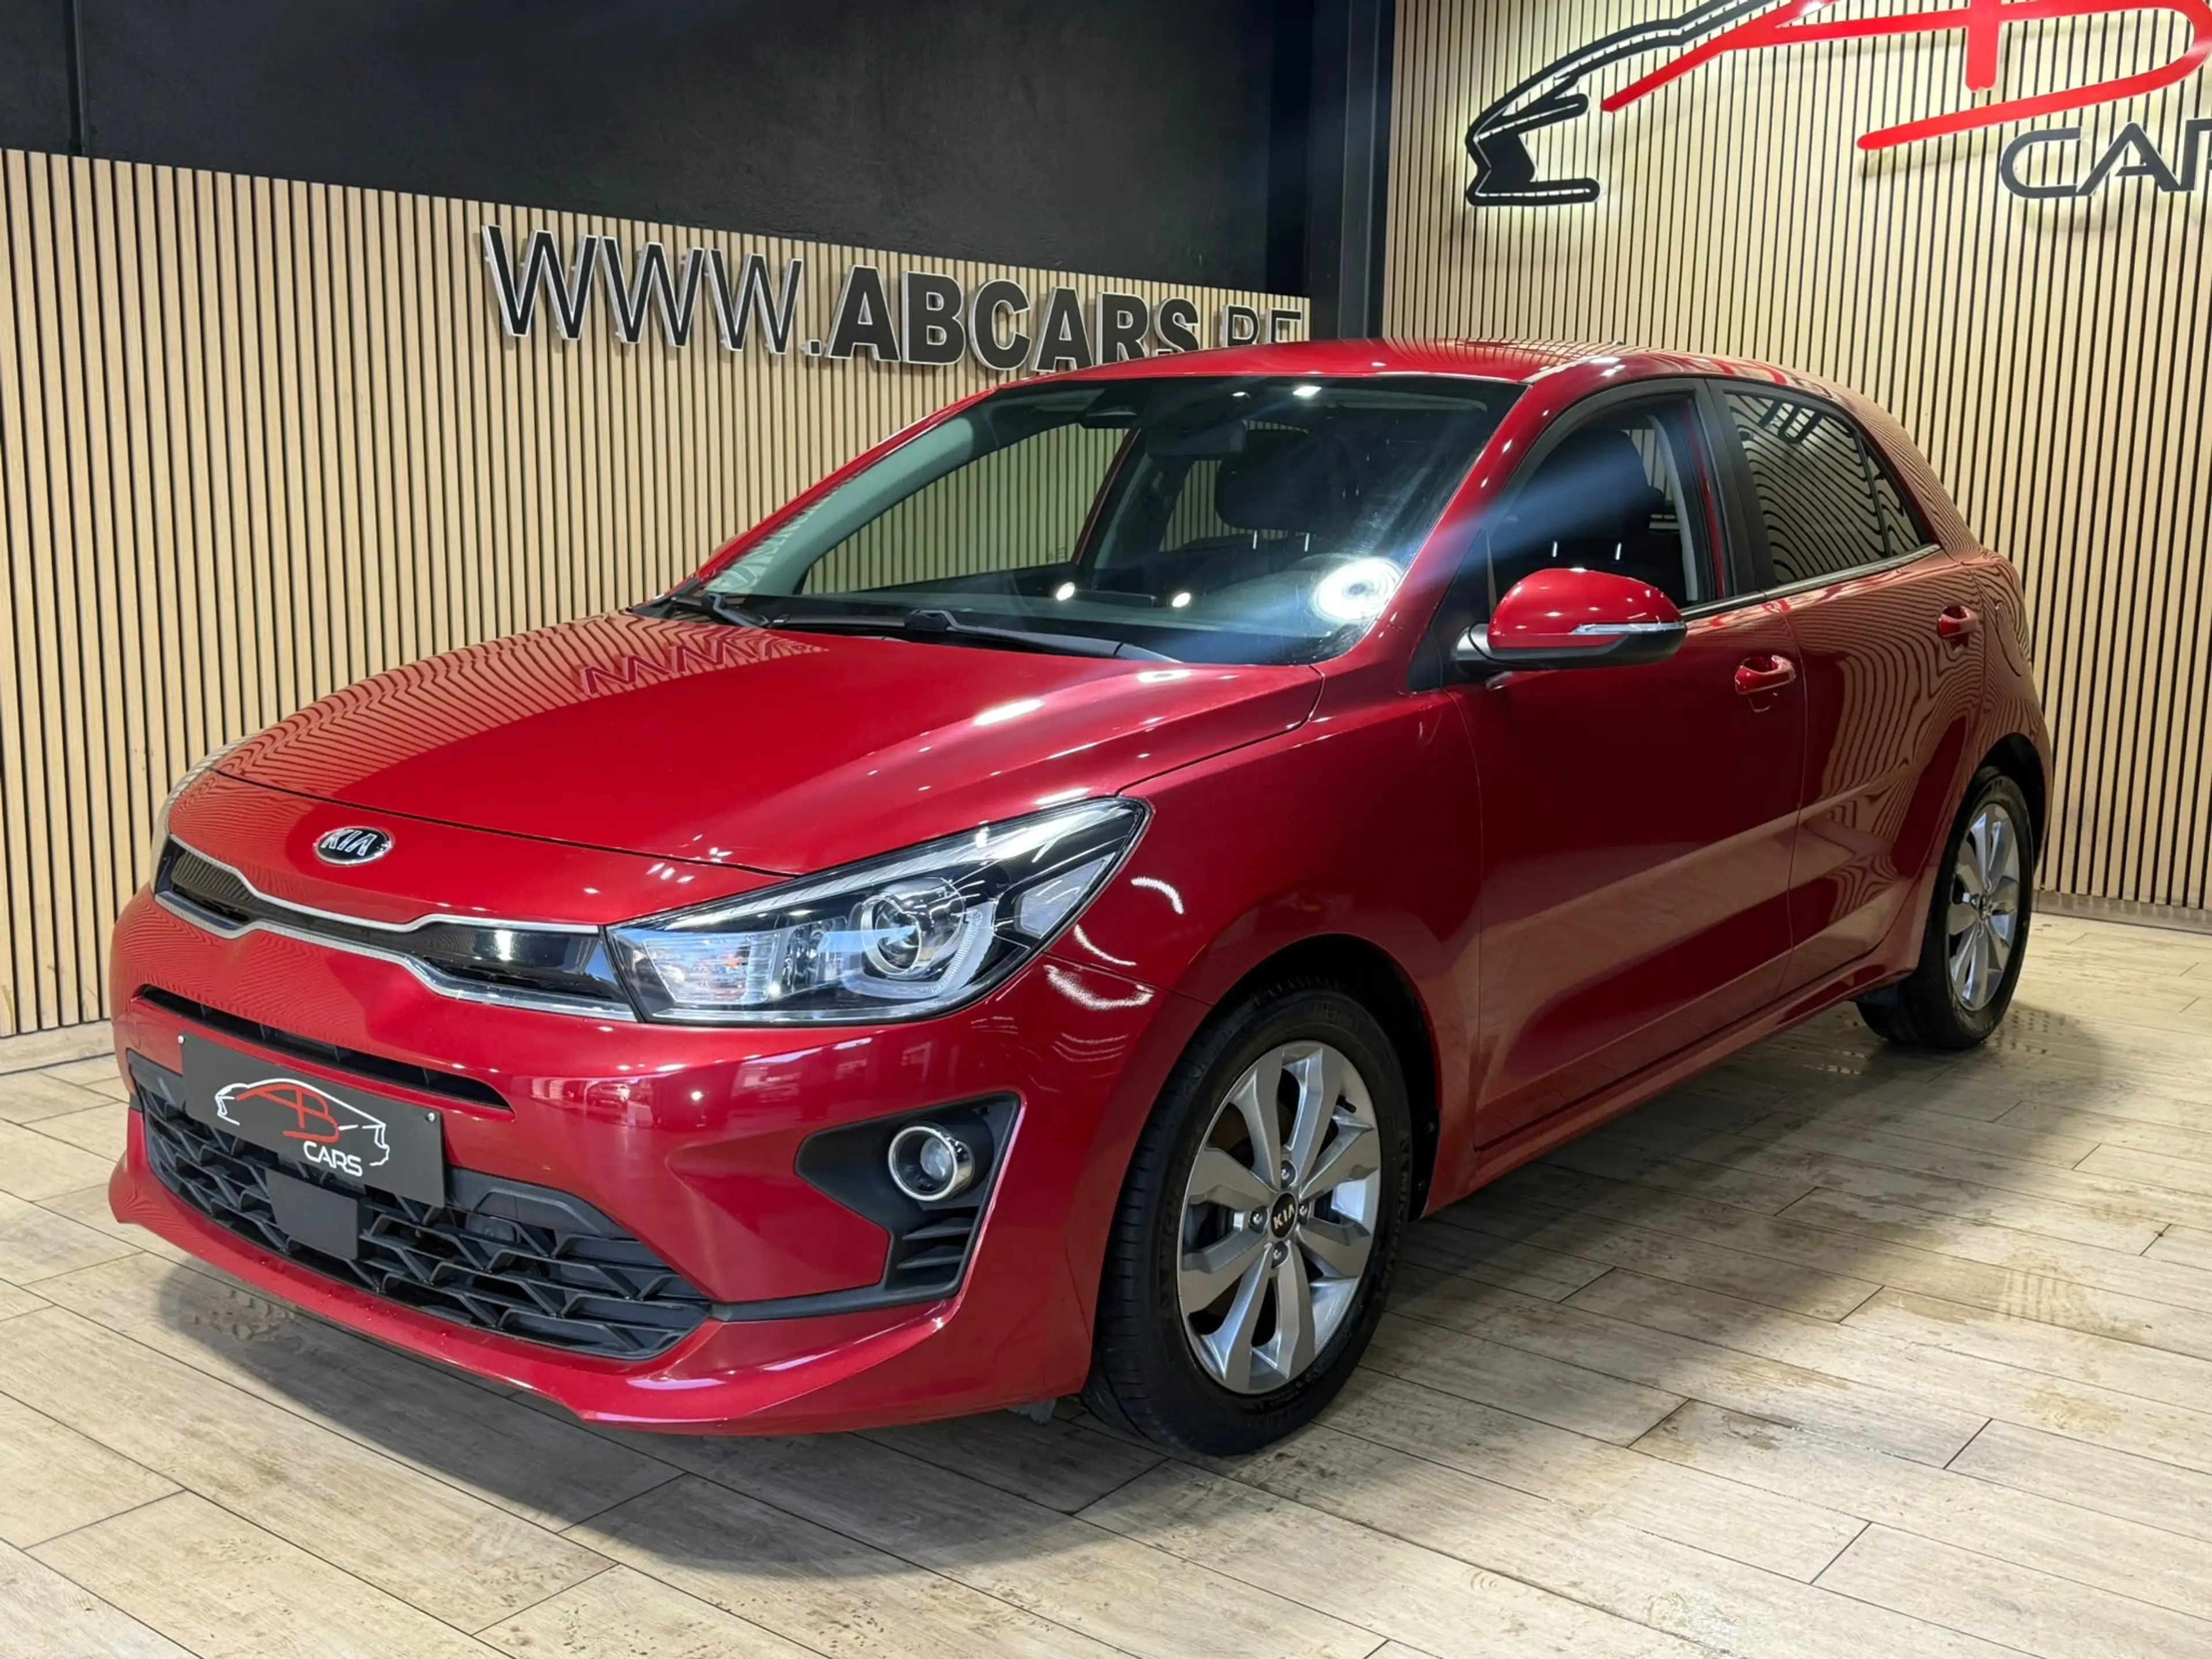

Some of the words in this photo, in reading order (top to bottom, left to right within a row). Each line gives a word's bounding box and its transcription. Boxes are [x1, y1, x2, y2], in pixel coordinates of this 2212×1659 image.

[320, 829, 378, 857] KIA
[303, 1141, 363, 1176] CARS
[1273, 1203, 1295, 1229] KIA
